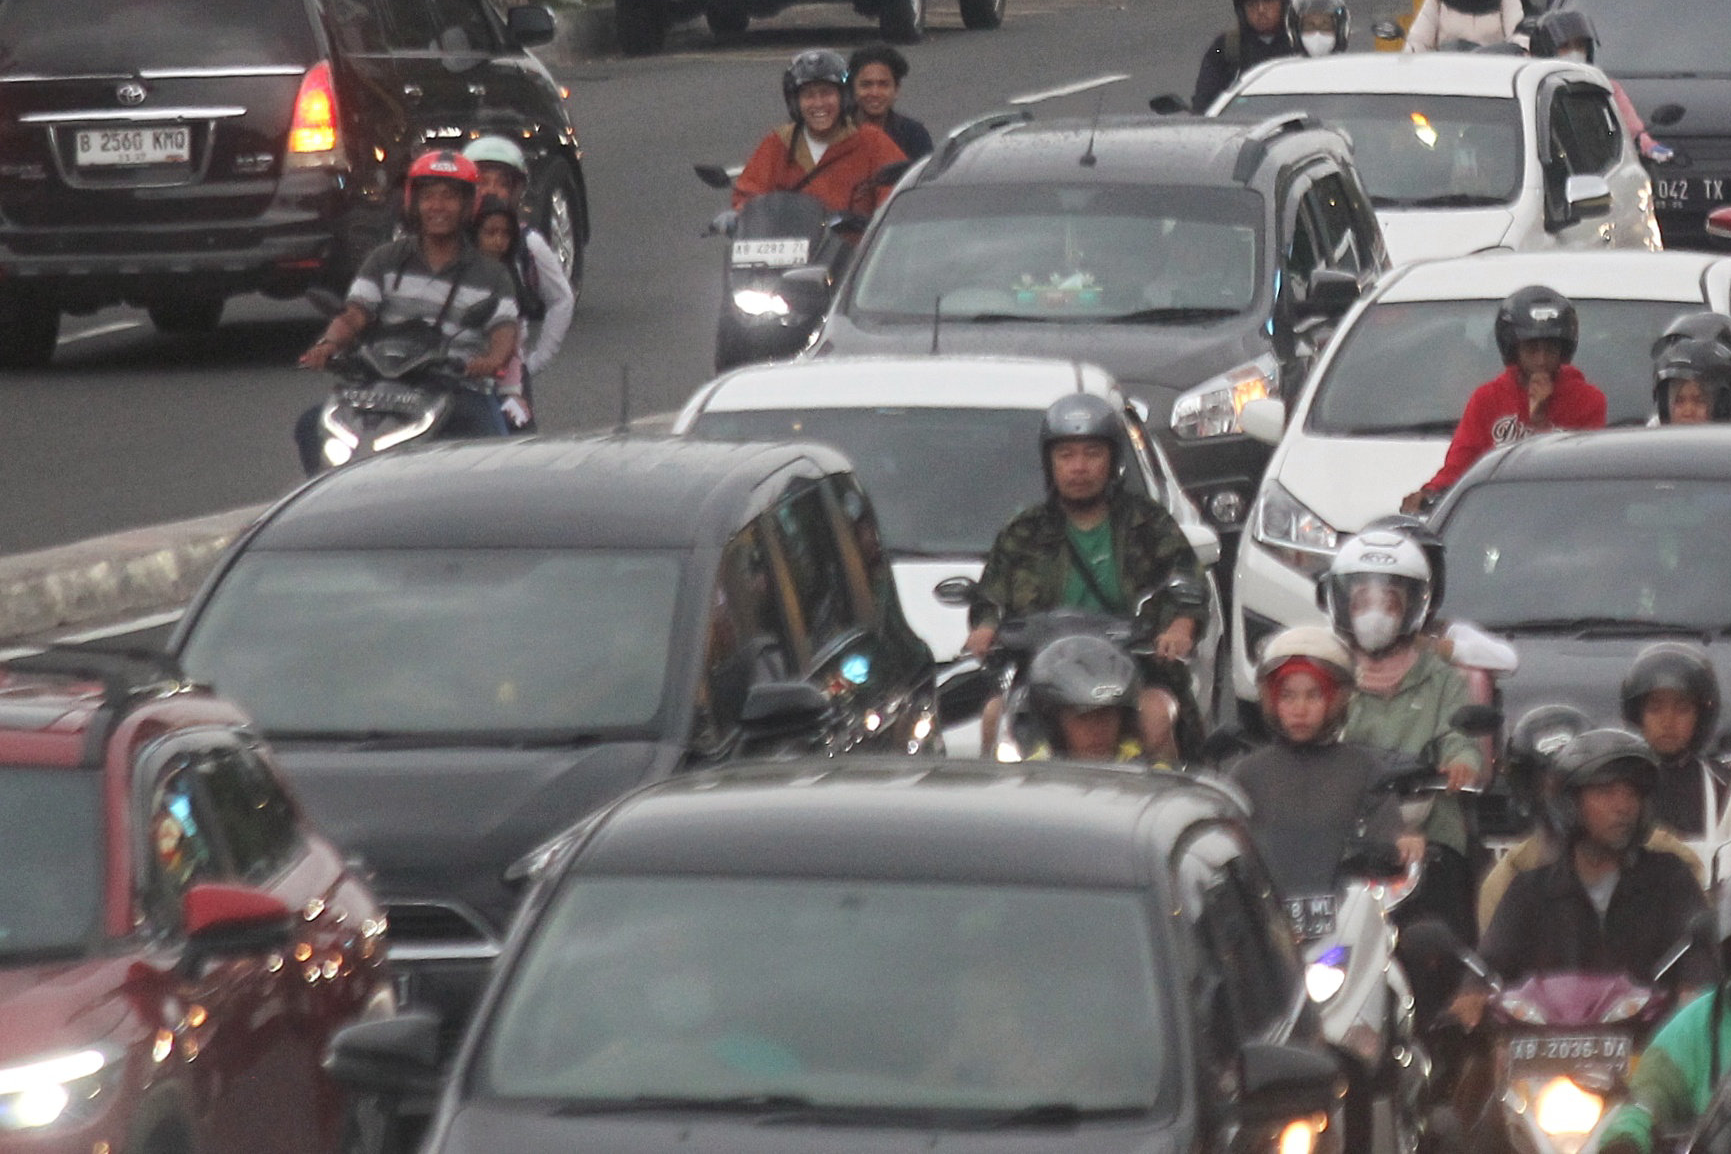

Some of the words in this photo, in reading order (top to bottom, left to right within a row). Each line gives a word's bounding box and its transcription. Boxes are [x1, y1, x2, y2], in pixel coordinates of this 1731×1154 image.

[80, 133, 91, 153] B
[152, 130, 185, 152] KMQ
[1703, 179, 1724, 200] TX
[1514, 1042, 1537, 1059] AB
[1602, 1039, 1626, 1057] DA
